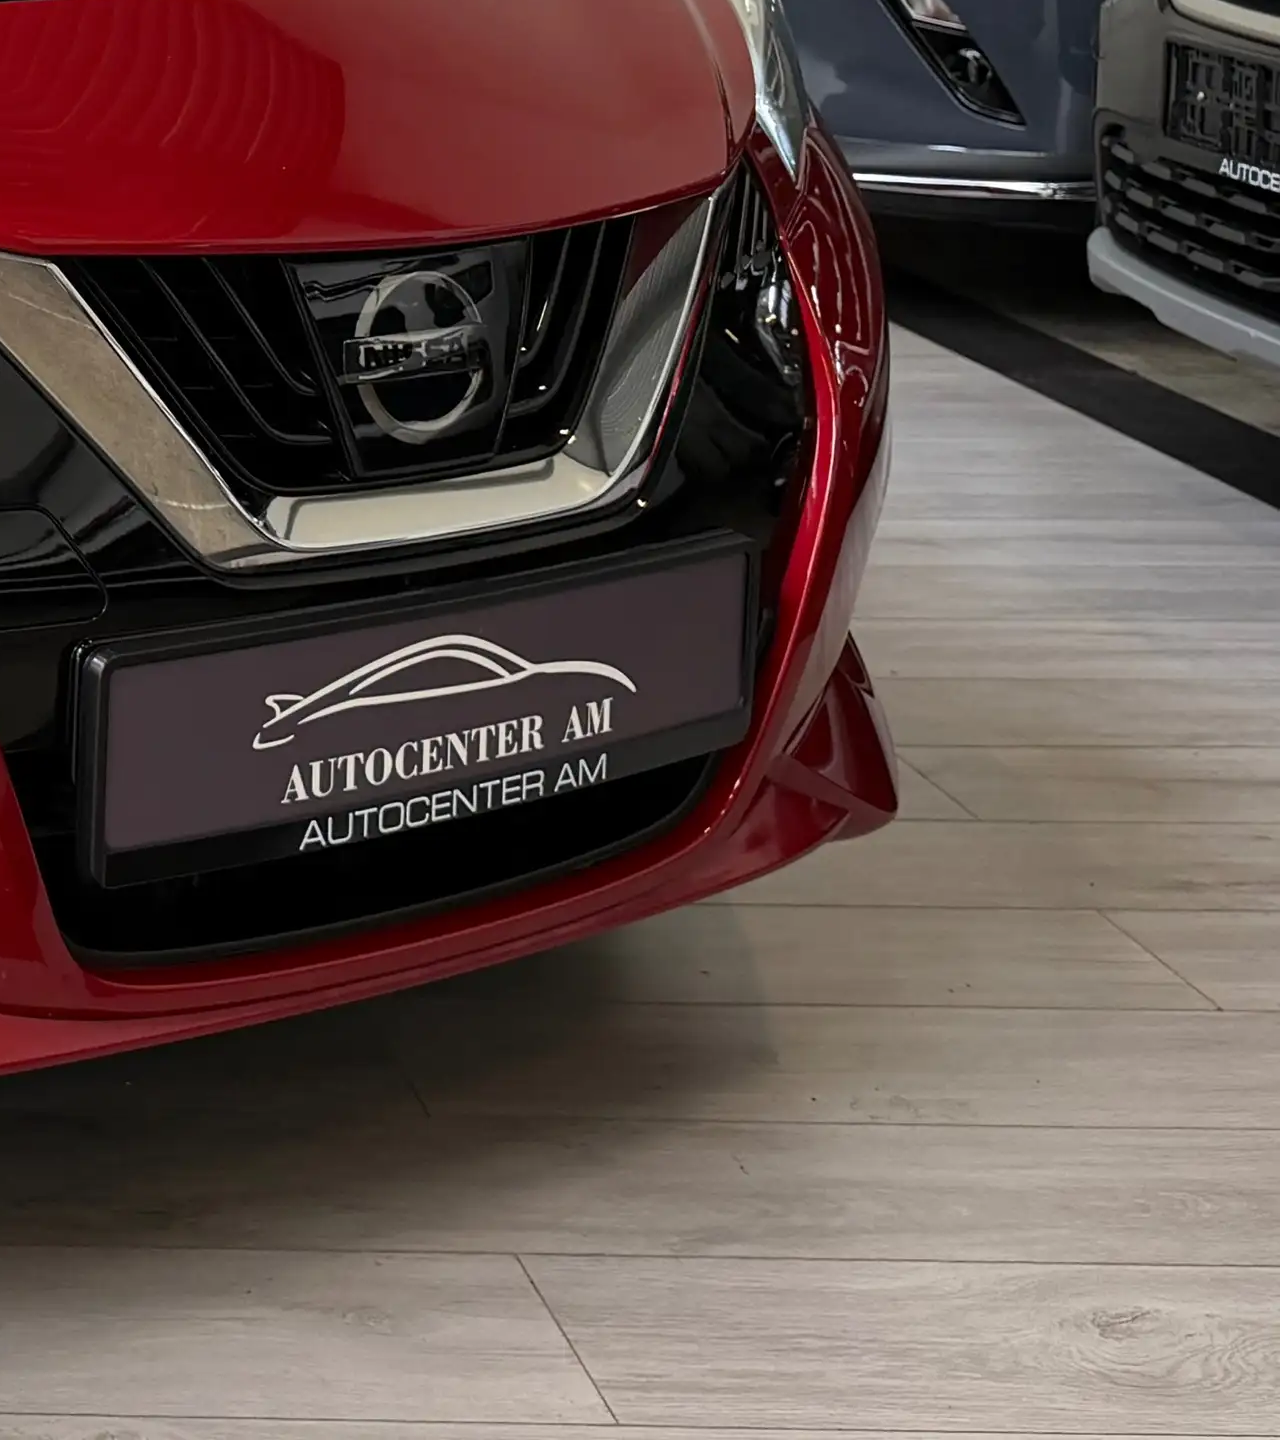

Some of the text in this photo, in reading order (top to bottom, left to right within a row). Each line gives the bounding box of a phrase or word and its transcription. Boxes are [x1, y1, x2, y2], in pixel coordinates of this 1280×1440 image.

[280, 697, 614, 805] AUTOCENTER AM
[298, 752, 609, 852] AUTOCENTER AM
